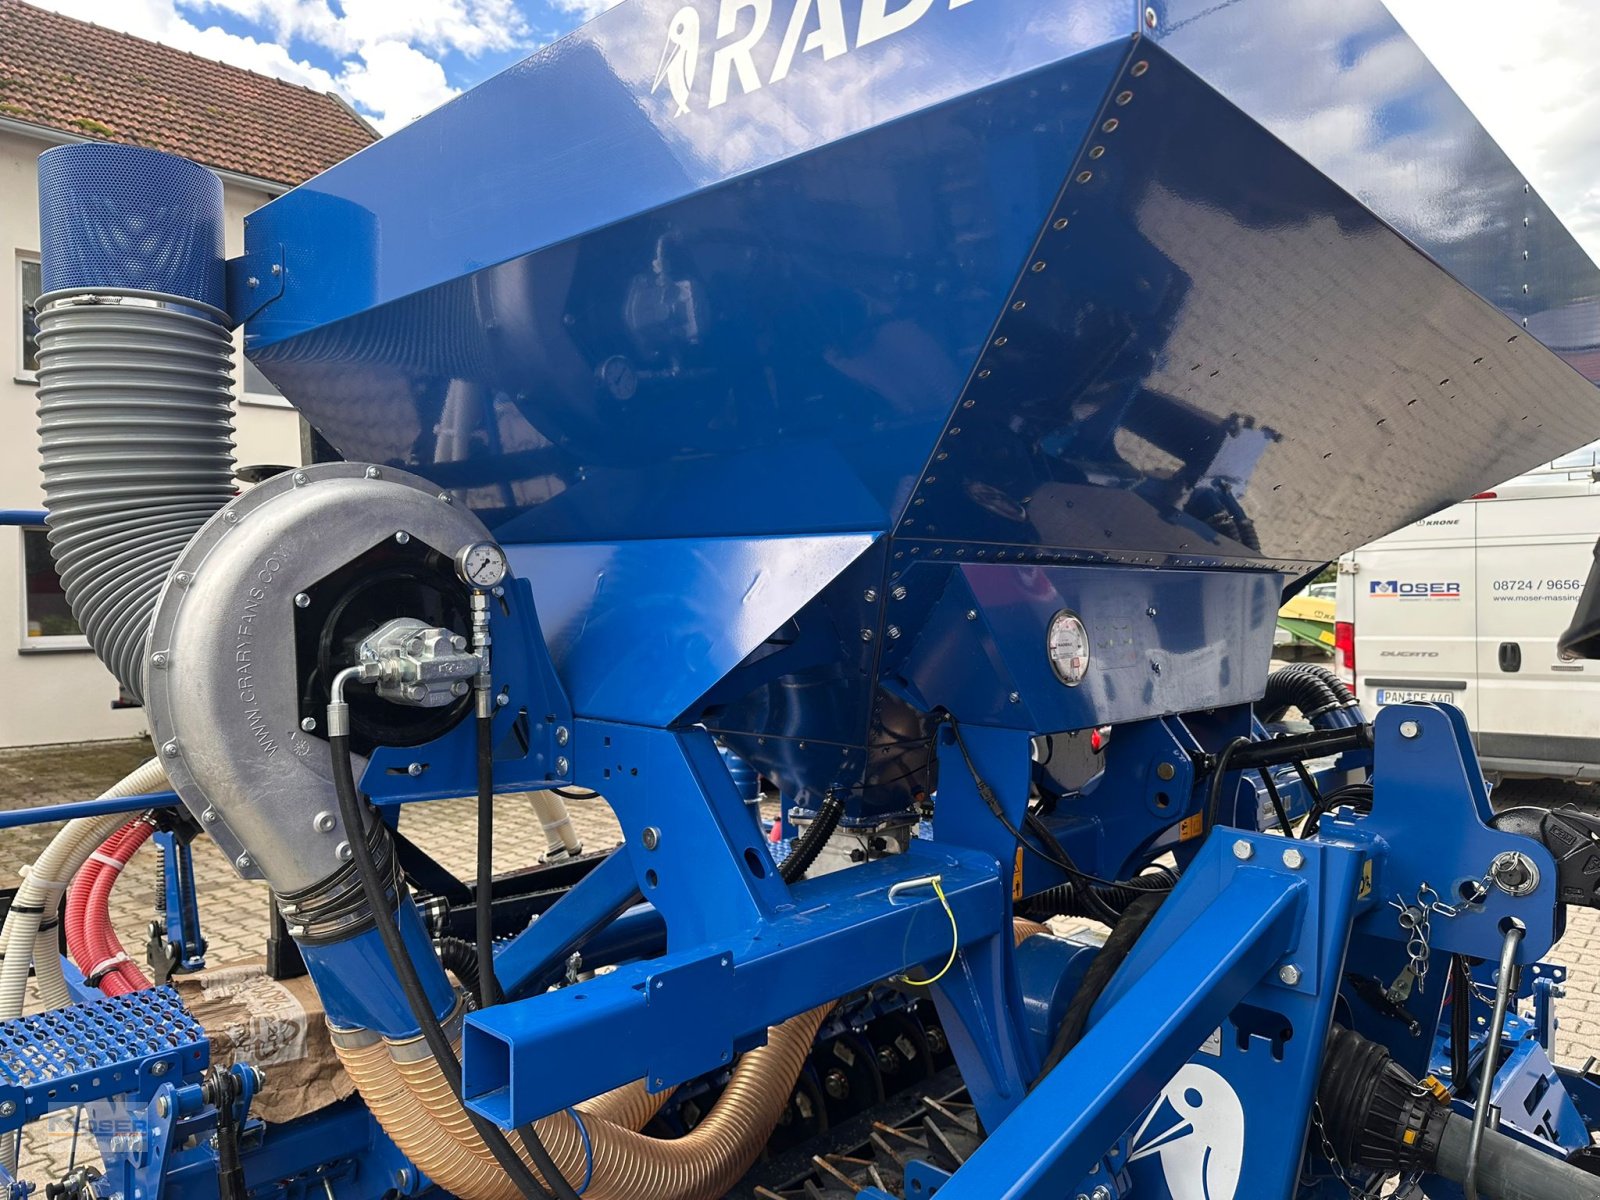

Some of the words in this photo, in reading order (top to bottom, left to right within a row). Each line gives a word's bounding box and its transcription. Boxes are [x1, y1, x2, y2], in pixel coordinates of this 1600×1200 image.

[1369, 580, 1460, 594] MOSER
[1493, 580, 1533, 591] 08724
[1385, 691, 1405, 702] PAN
